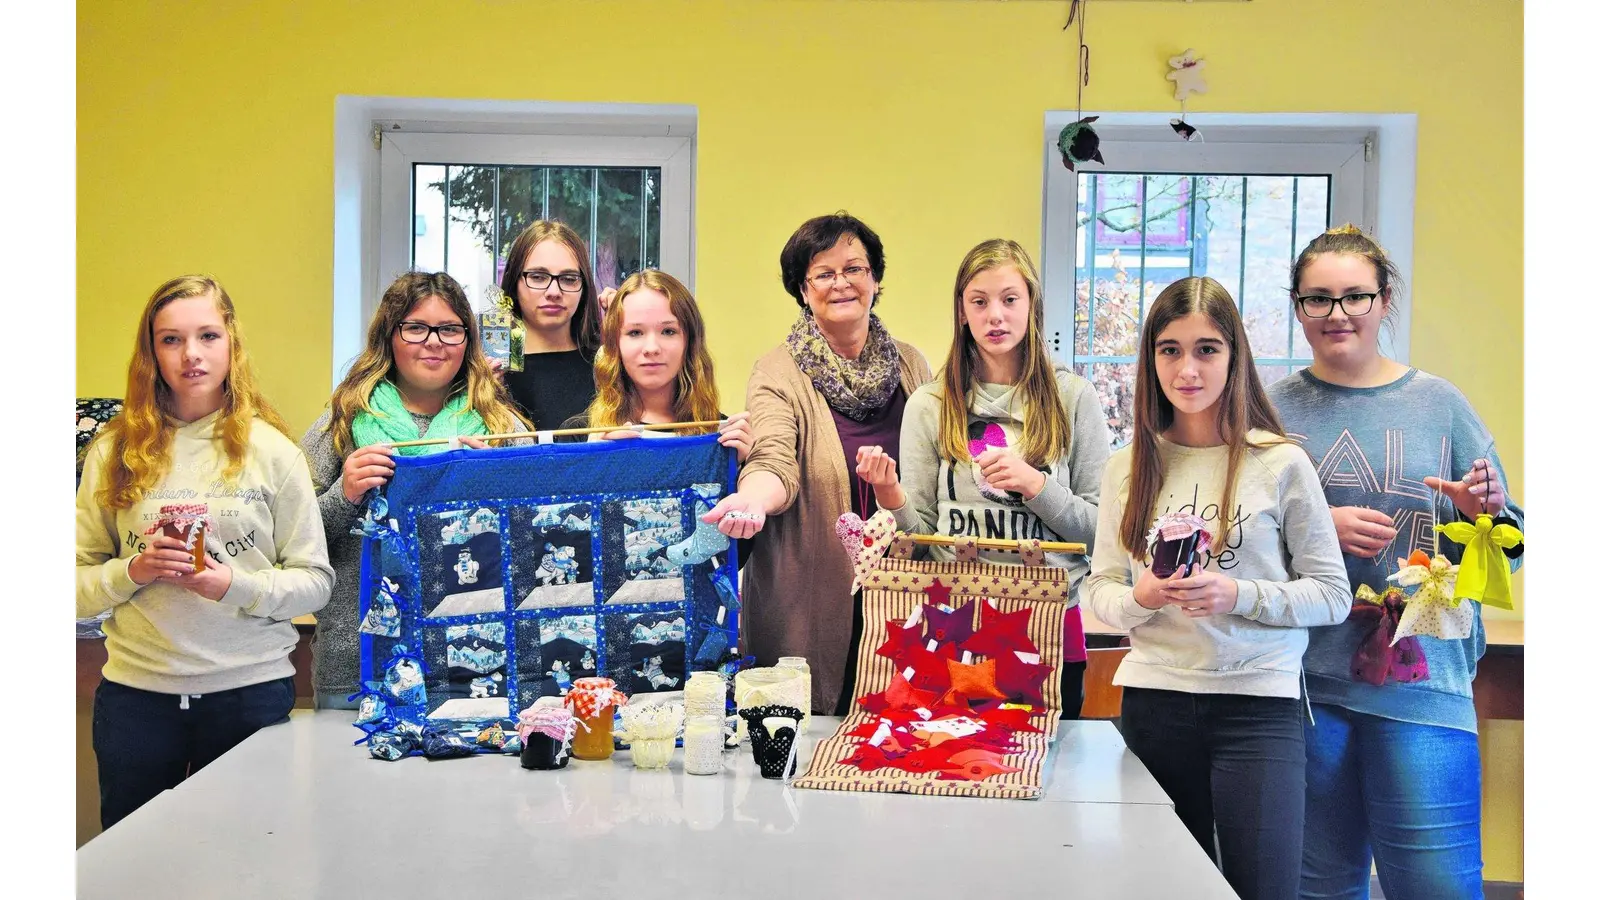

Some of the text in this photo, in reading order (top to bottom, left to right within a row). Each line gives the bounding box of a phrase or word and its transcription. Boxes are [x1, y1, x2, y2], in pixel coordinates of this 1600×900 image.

[220, 509, 240, 518] LXV
[1164, 483, 1251, 549] iday
[126, 530, 147, 554] Ne
[225, 530, 256, 558] City
[683, 547, 689, 557] 6
